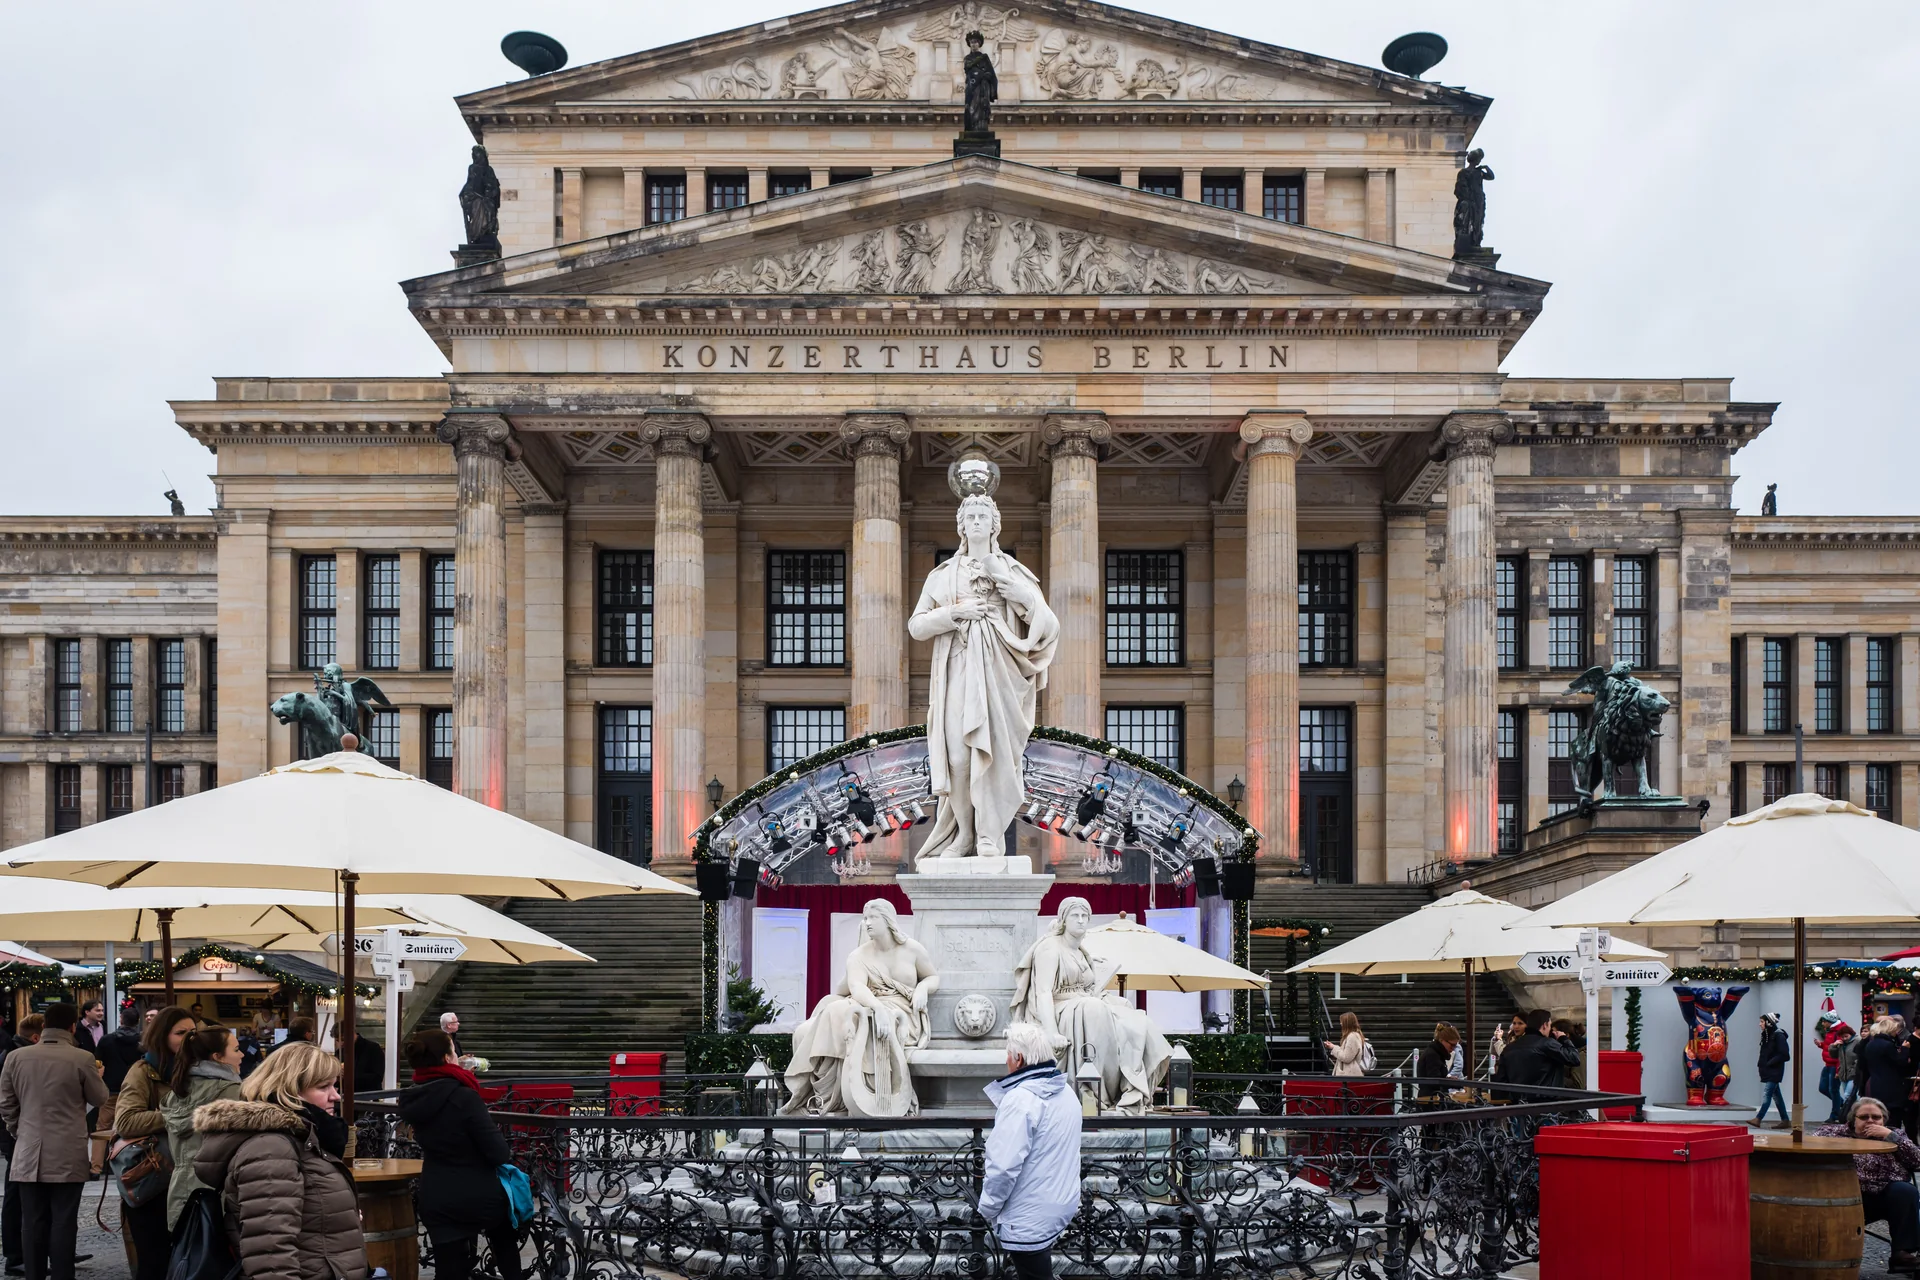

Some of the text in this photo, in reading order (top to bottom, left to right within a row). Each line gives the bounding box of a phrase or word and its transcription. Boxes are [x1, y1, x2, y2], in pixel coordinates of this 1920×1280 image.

[662, 345, 1288, 368] KONZERTHAUS BERLIN
[405, 943, 455, 954] Sanitäter
[1537, 955, 1572, 970] WC
[1605, 970, 1660, 981] Sanitäter
